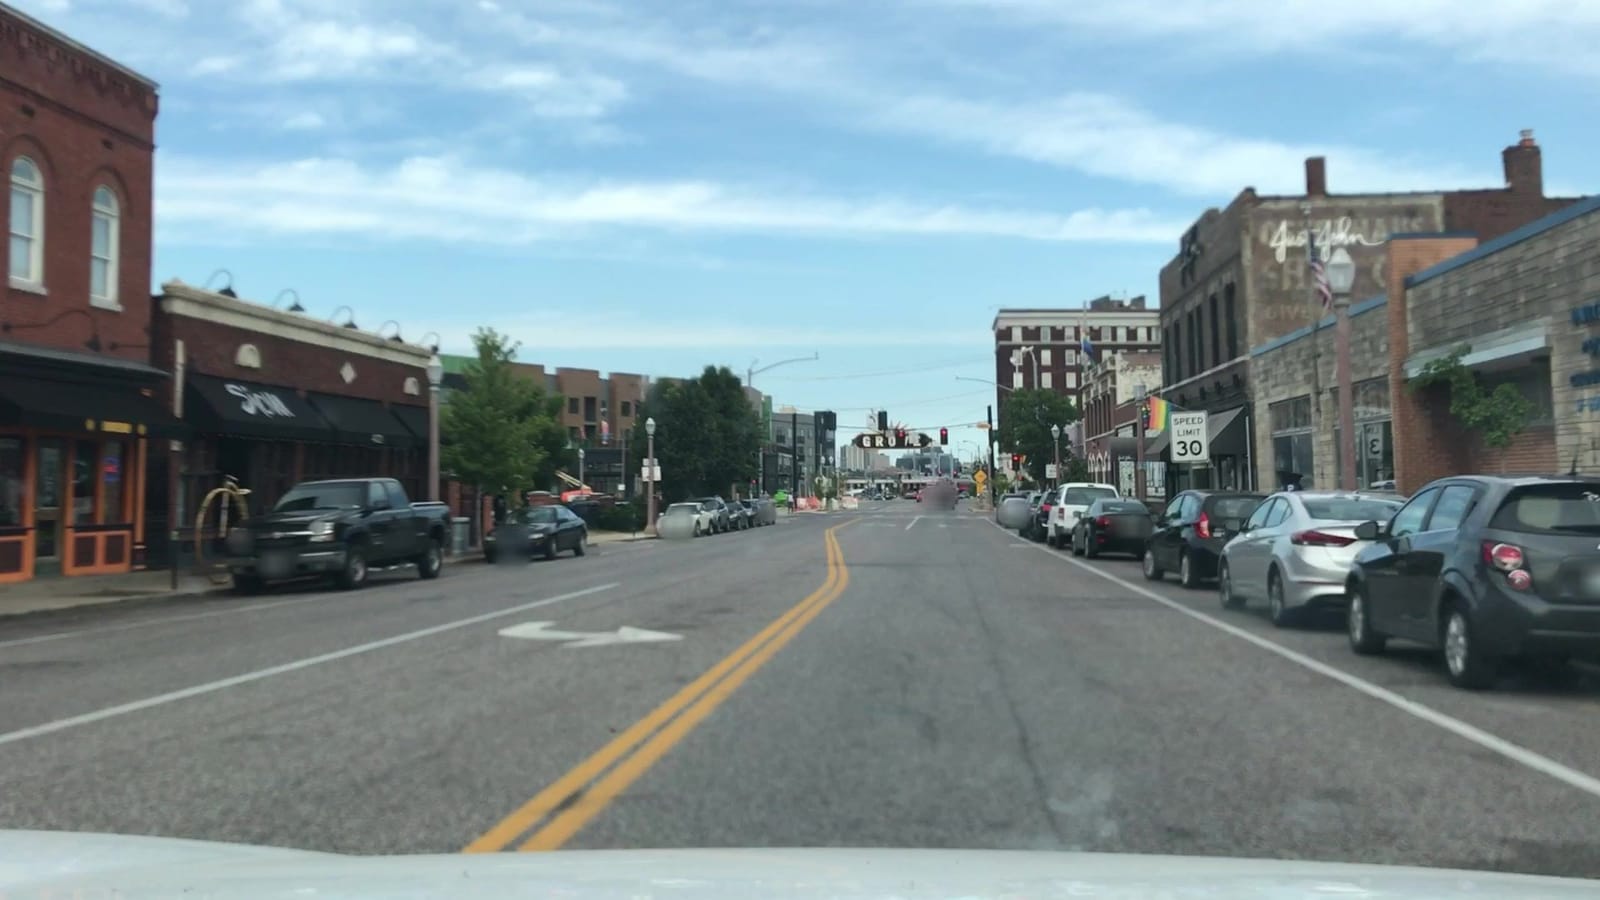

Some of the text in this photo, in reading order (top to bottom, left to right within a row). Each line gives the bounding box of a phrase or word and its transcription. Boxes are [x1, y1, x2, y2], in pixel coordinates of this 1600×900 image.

[1269, 219, 1321, 263] Jus
[1173, 416, 1204, 426] SPEED
[1177, 428, 1200, 437] LIMIT
[1176, 440, 1202, 456] 30
